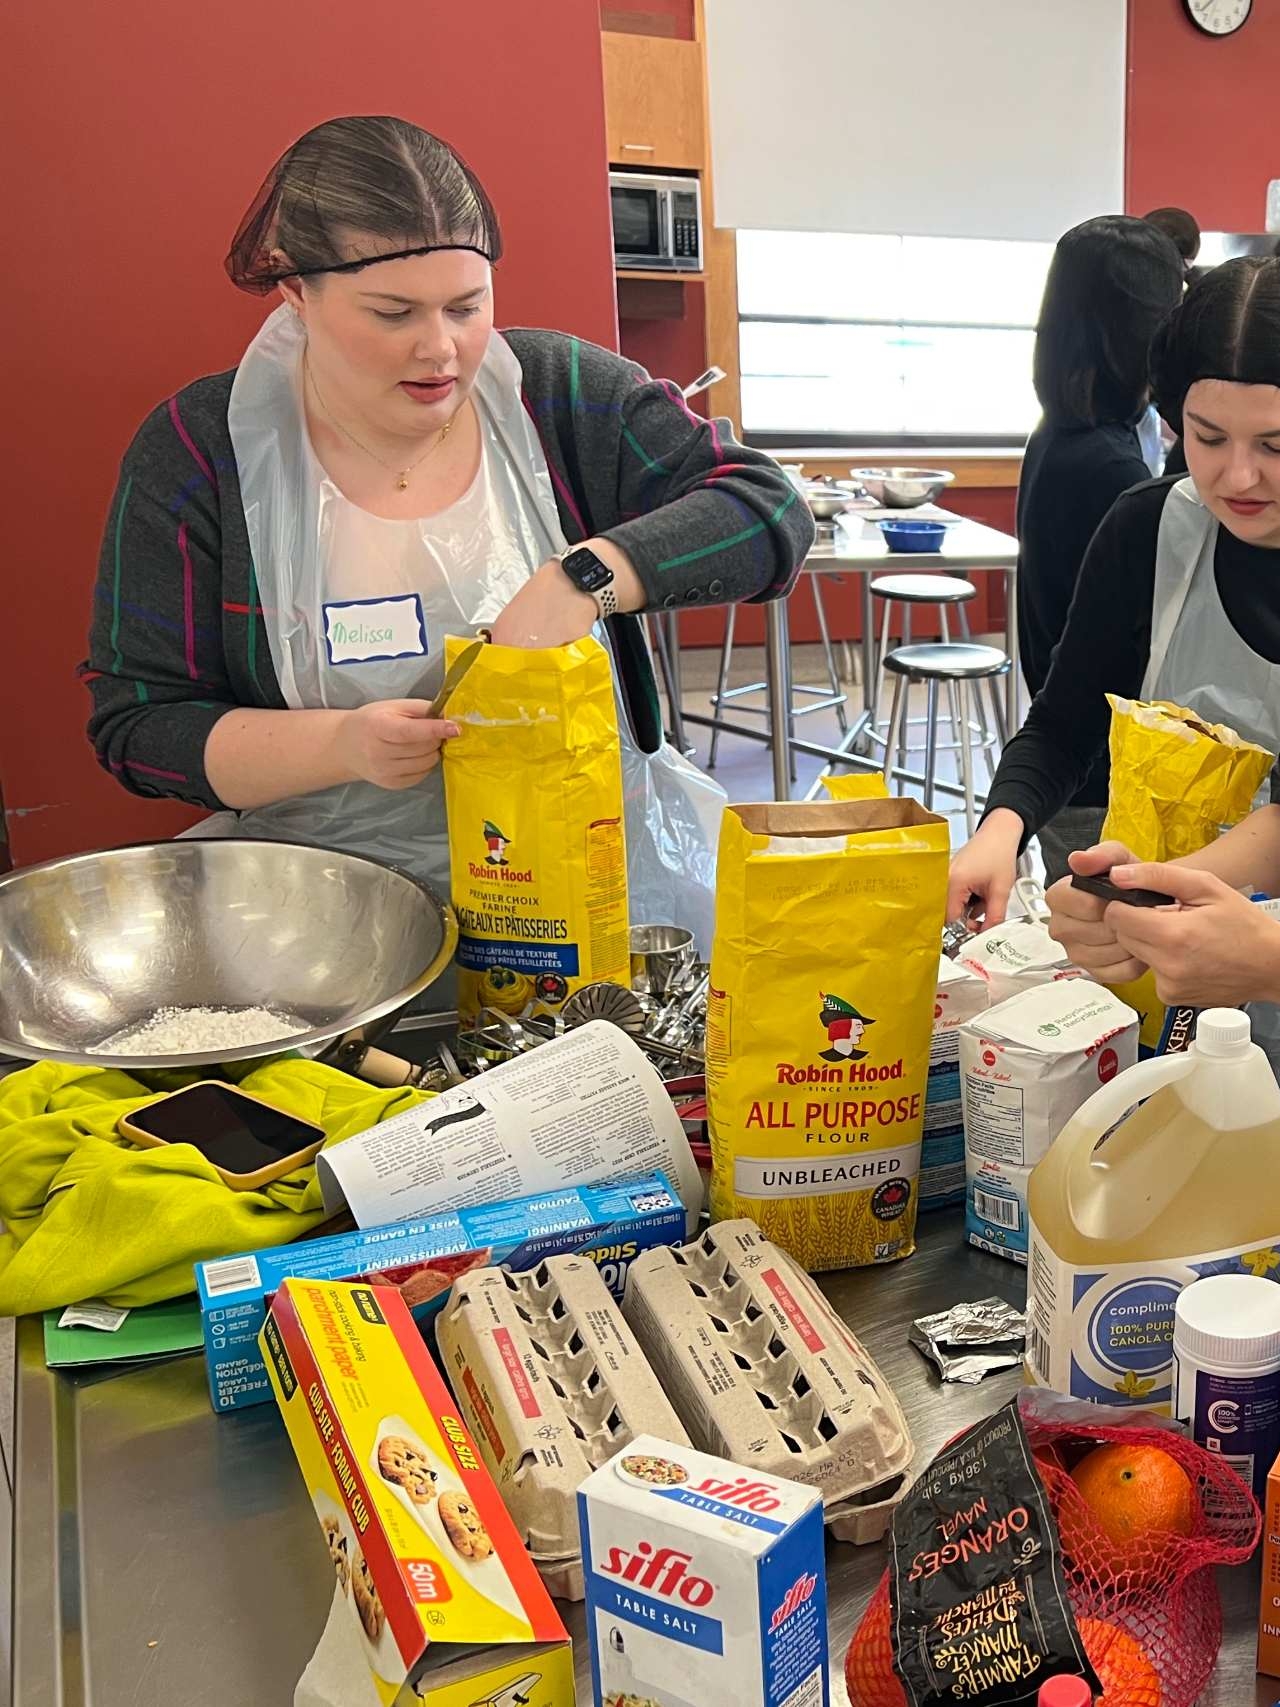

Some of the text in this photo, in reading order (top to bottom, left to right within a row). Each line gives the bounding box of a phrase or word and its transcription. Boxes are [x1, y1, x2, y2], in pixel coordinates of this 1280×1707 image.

[333, 621, 393, 645] Melissa
[469, 863, 532, 882] Robin Hood
[469, 889, 539, 906] PREMIER CHOIX
[483, 903, 517, 913] FARINE
[505, 914, 567, 939] PÂTISSERIES
[526, 950, 558, 960] TEXTURE
[1167, 1008, 1193, 1054] KER'S
[776, 1059, 903, 1085] Robin Hood
[744, 1092, 921, 1130] ALL PURPOSE
[805, 1132, 870, 1144] FLOUR
[762, 1159, 902, 1186] UNBLEACHED
[530, 1195, 580, 1211] CAUTION
[364, 1217, 460, 1244] MISE EN GARDE
[528, 1216, 592, 1237] WARNING!
[365, 1241, 468, 1271] AVERTISSEMENT
[1110, 1301, 1176, 1316] complime
[305, 1285, 341, 1343] parchment
[330, 1341, 361, 1384] paper
[1110, 1324, 1143, 1335] 100%
[1110, 1335, 1161, 1347] CANOLA
[215, 1358, 249, 1370] GRAND
[216, 1362, 267, 1378] NGÉLATION
[217, 1376, 248, 1388] LARGE
[219, 1379, 269, 1396] FREEZER
[220, 1395, 236, 1406] 10
[441, 1415, 480, 1471] CLUB SIZE
[984, 1419, 1012, 1447] PRODUCT
[308, 1382, 370, 1533] CLUB SIZE FORMAT CLUB
[933, 1481, 942, 1494] 3
[949, 1471, 965, 1486] kg
[688, 1478, 781, 1514] sifto
[922, 1486, 933, 1500] lb
[679, 1493, 760, 1527] TABLE SALT
[936, 1496, 988, 1541] NAVEL
[908, 1507, 1029, 1582] ORANGES
[600, 1541, 714, 1608] sifto
[615, 1593, 698, 1636] TABLE SALT
[768, 1572, 818, 1635] sifto
[775, 1599, 813, 1640] TABLE SALT
[941, 1599, 1018, 1642] DÉLICES
[952, 1623, 1023, 1673] MARKET
[952, 1644, 1041, 1700] FARMER'S
